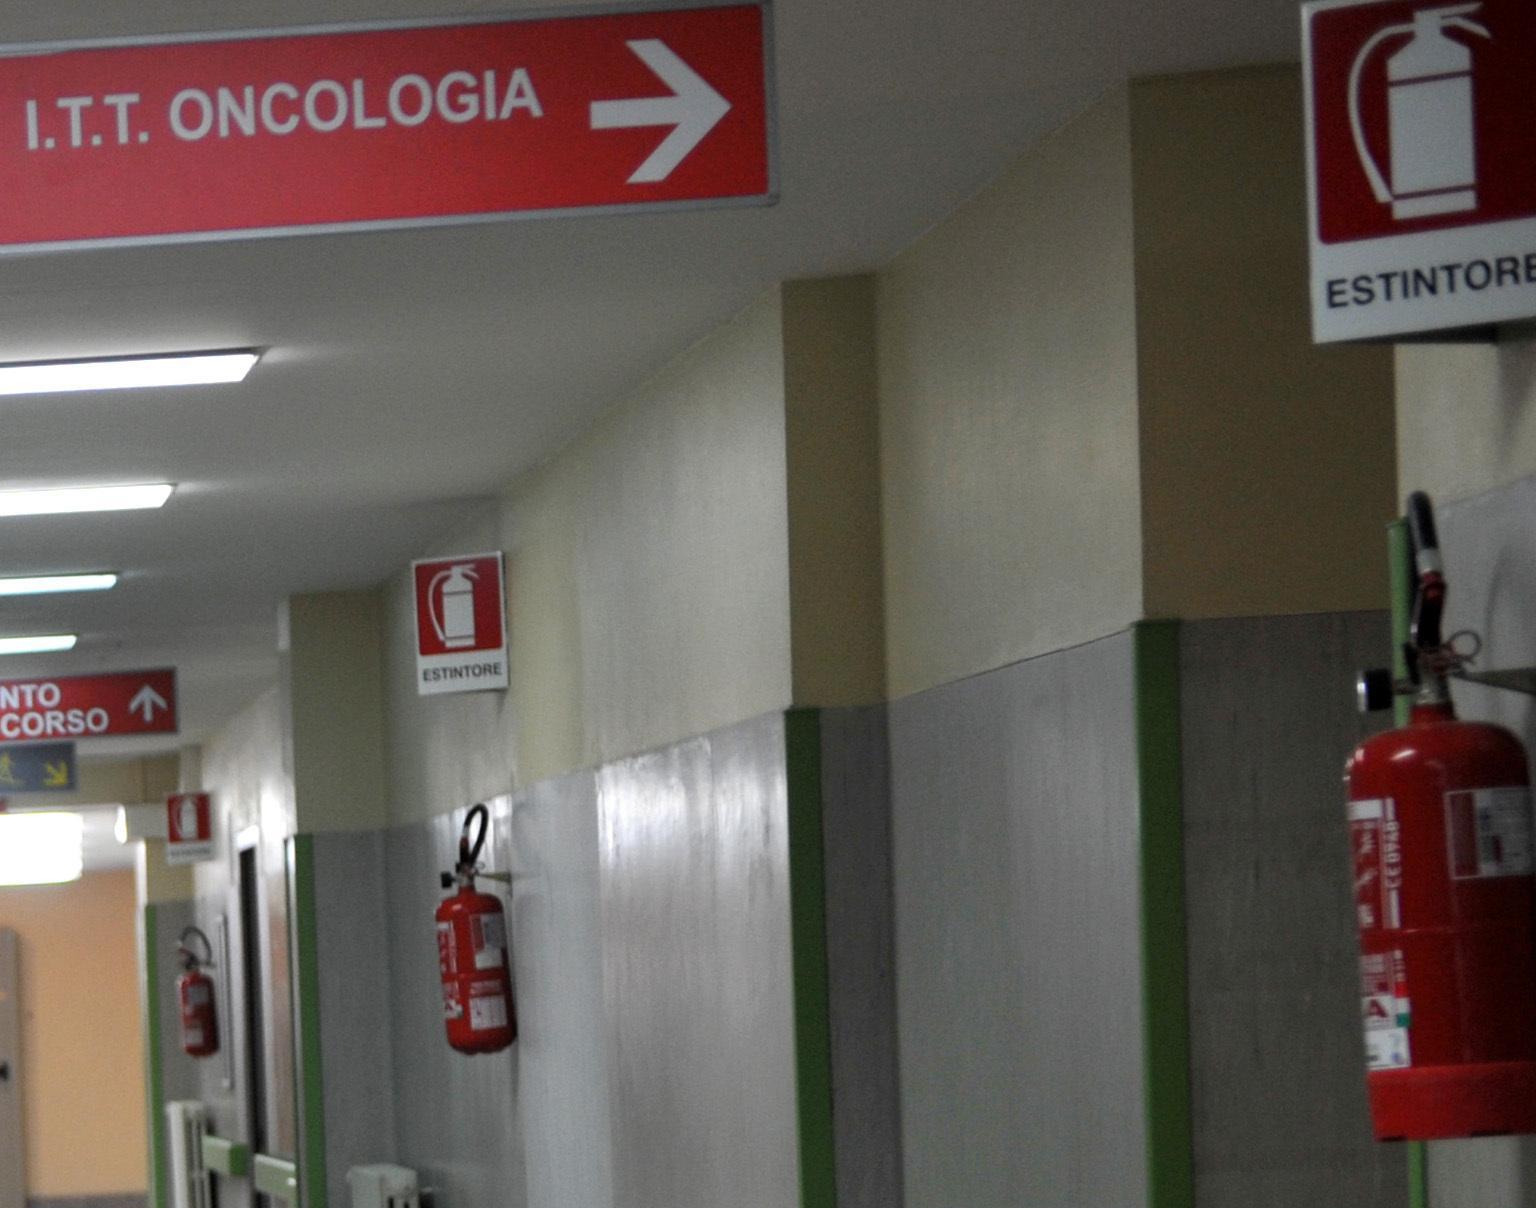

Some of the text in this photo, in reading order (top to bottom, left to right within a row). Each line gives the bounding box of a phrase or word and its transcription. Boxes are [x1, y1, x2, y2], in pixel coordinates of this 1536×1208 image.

[25, 67, 544, 150] I.T.T. ONCOLOGIA
[423, 663, 502, 682] ESTINTORE
